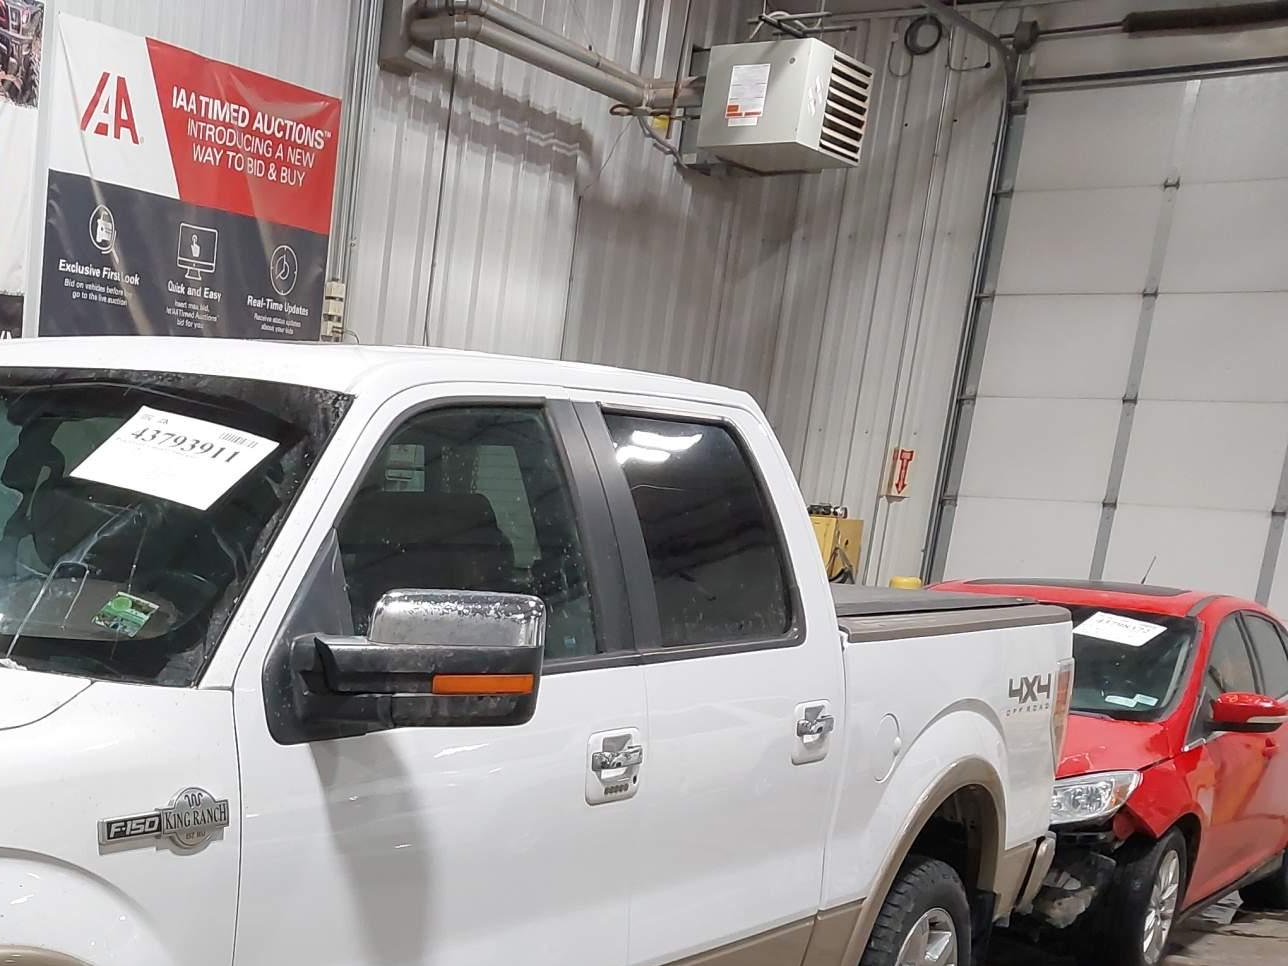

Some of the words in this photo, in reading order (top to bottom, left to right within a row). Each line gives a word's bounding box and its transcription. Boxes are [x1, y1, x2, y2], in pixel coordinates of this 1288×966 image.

[172, 86, 197, 114] IAA
[199, 95, 249, 128] TIMED
[188, 118, 273, 158] INTRODUCING
[275, 144, 284, 161] A
[287, 146, 315, 168] NEW
[193, 143, 223, 166] WAY
[226, 151, 245, 171] TO
[247, 157, 265, 177] BID
[267, 163, 277, 181] &
[280, 166, 306, 187] BUY
[58, 259, 101, 277] Exclusive
[102, 267, 121, 281] First
[168, 280, 186, 294] Quick
[187, 286, 202, 297] and
[203, 287, 222, 303] Easy
[247, 295, 283, 311] Real-Time
[284, 301, 309, 316] Updates
[130, 427, 241, 463] 43793911
[164, 811, 191, 831] KING
[192, 803, 227, 826] RANCH
